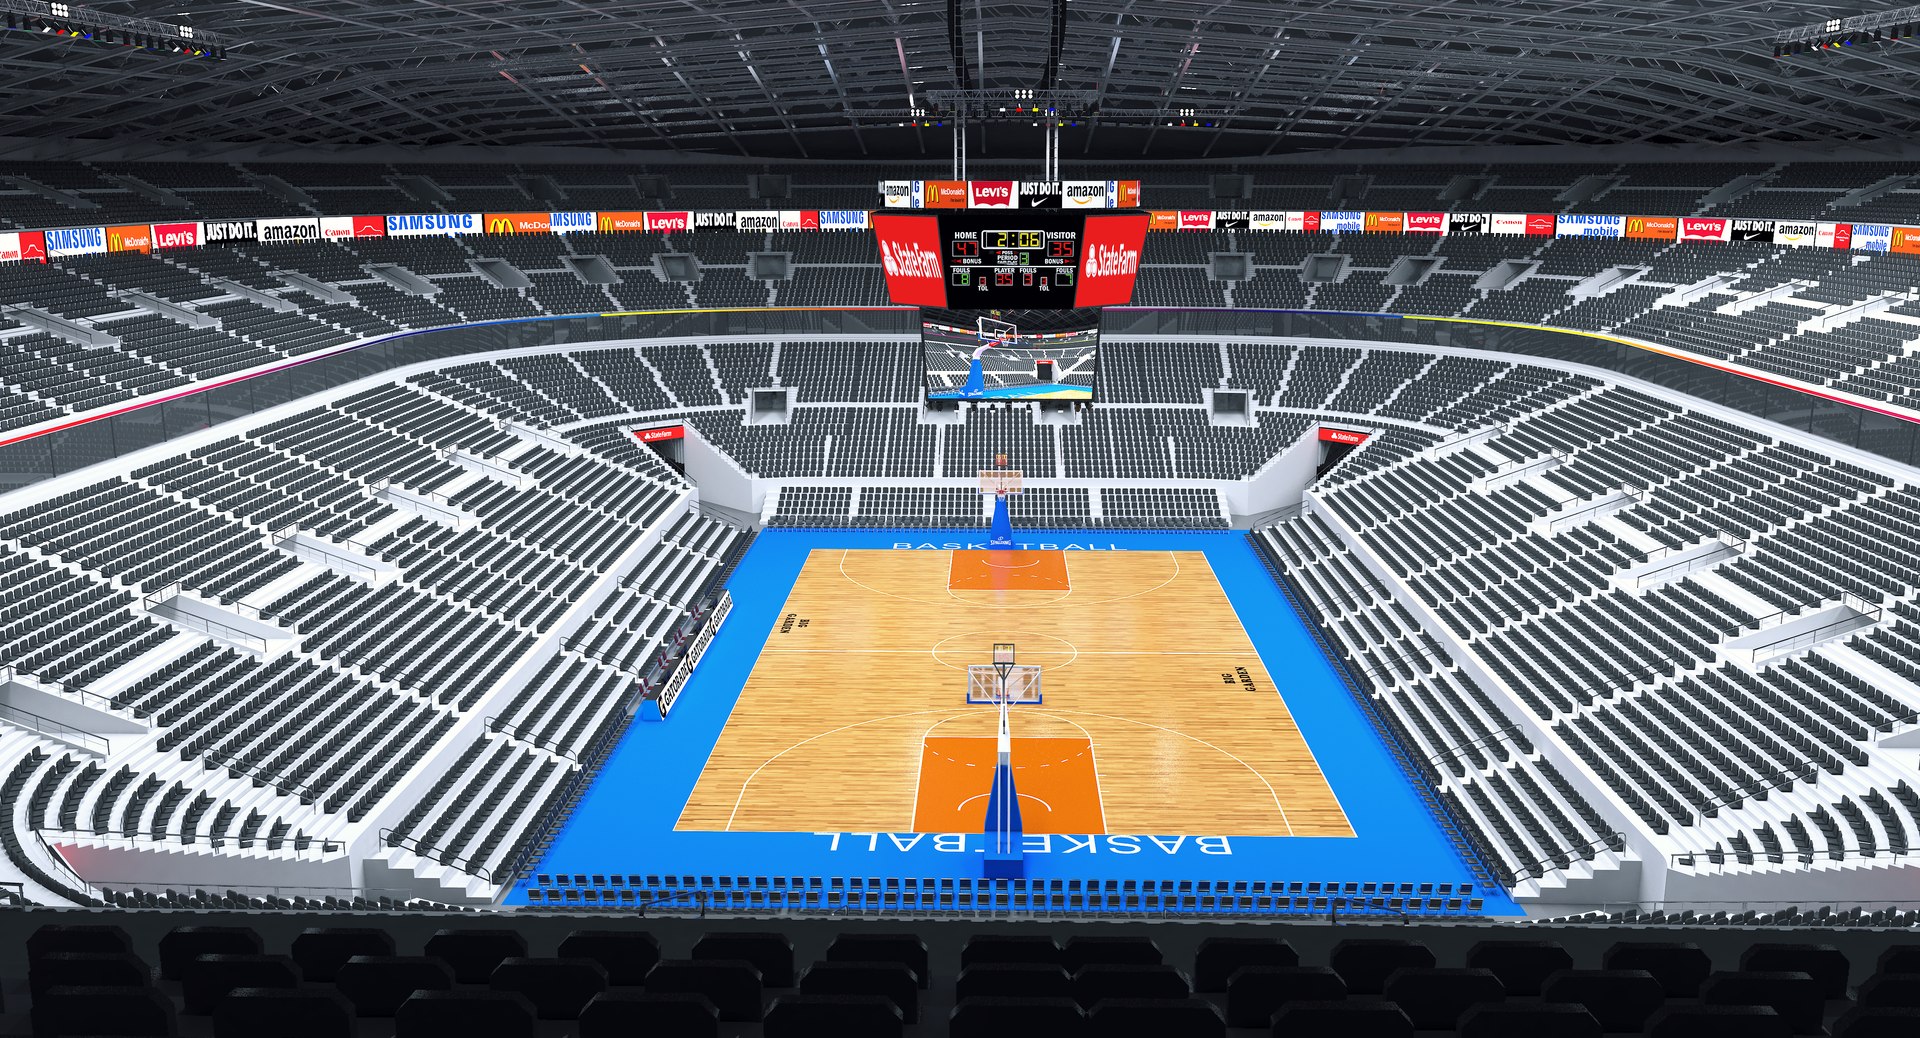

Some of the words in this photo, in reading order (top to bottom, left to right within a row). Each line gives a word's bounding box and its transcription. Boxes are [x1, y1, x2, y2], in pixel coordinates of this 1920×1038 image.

[1020, 182, 1039, 195] JUST
[1040, 182, 1051, 195] DO
[1051, 182, 1062, 195] IT.
[1067, 185, 1105, 197] amazon
[695, 213, 713, 226] JUST
[714, 213, 725, 226] DO
[725, 212, 736, 226] IT.
[821, 210, 864, 224] SAMSUNG
[1217, 211, 1231, 220] JUST
[1231, 211, 1241, 220] DO
[1241, 211, 1250, 220] IT.
[1253, 213, 1284, 222] amazon
[1321, 211, 1361, 220] SAMSUNG
[1451, 213, 1469, 223] JUST
[1469, 213, 1481, 223] DO
[1558, 214, 1620, 225] SAMSUNG
[388, 213, 473, 231] SAMSUNG
[741, 216, 778, 228] amazon
[1336, 221, 1360, 231] mobile
[1646, 221, 1675, 229] McDonald's
[1733, 220, 1752, 231] JUST
[1752, 220, 1764, 232] DO
[1764, 221, 1775, 232] IT.
[206, 222, 228, 241] JUST
[228, 222, 243, 240] DO
[243, 222, 257, 239] IT.
[264, 224, 317, 240] amazon
[324, 228, 351, 237] Canon
[954, 231, 978, 240] HOME
[1045, 231, 1077, 240] VISITOR
[1583, 226, 1619, 236] mobile
[1778, 224, 1814, 236] amazon
[1852, 224, 1890, 238] SAMSUNG
[46, 227, 102, 251] SAMSUNG
[1865, 239, 1887, 251] mobile
[956, 241, 978, 257] 47
[1053, 241, 1073, 257] 35
[961, 273, 969, 285] 8
[892, 542, 1128, 550] BASKTBALL
[663, 662, 689, 707] GATORADE
[690, 625, 711, 664] GATORADE
[713, 594, 733, 627] GATORADE
[1234, 666, 1257, 692] GARDEN
[813, 832, 1233, 855] BASKEBALL
